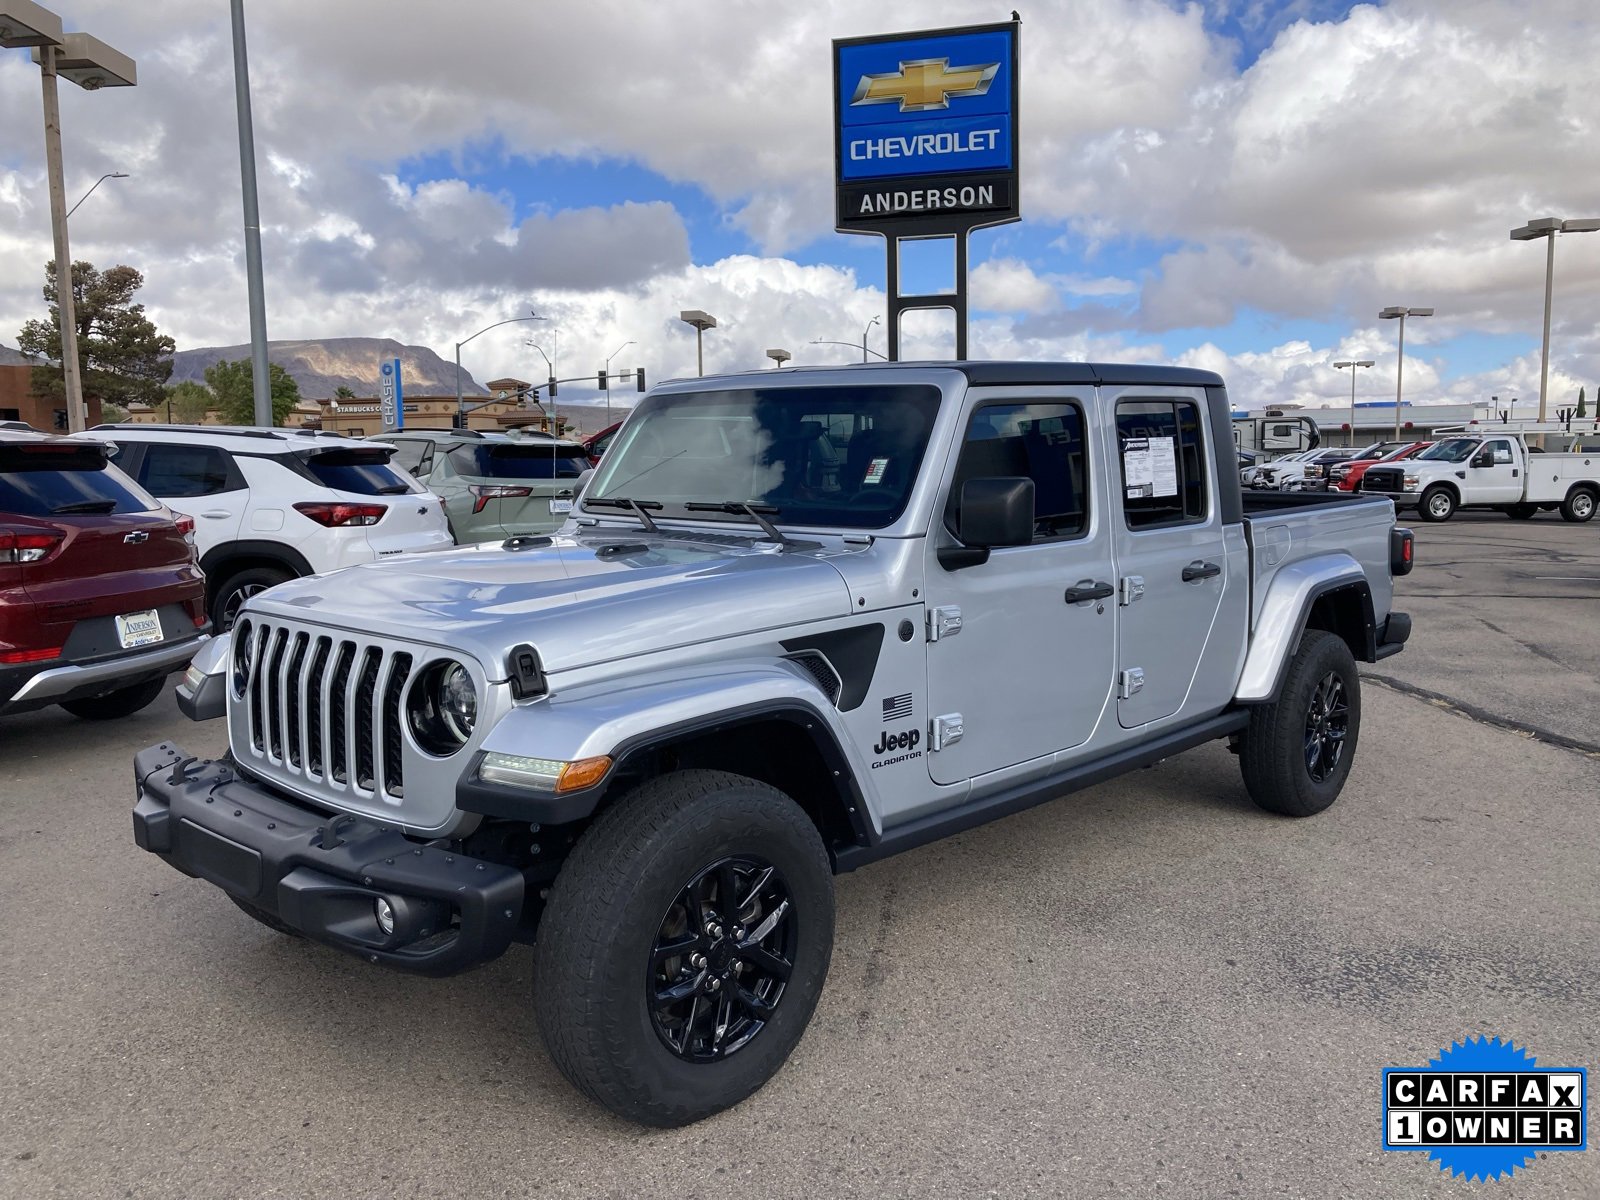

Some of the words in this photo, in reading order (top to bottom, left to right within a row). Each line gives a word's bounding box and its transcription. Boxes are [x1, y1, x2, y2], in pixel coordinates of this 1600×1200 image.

[850, 129, 1000, 160] CHEVROLET
[859, 185, 993, 213] ANDERSON
[336, 405, 374, 413] STARBUCKS
[383, 377, 394, 425] CHASE
[873, 728, 920, 755] Jeep
[871, 751, 922, 769] GLADIATOR
